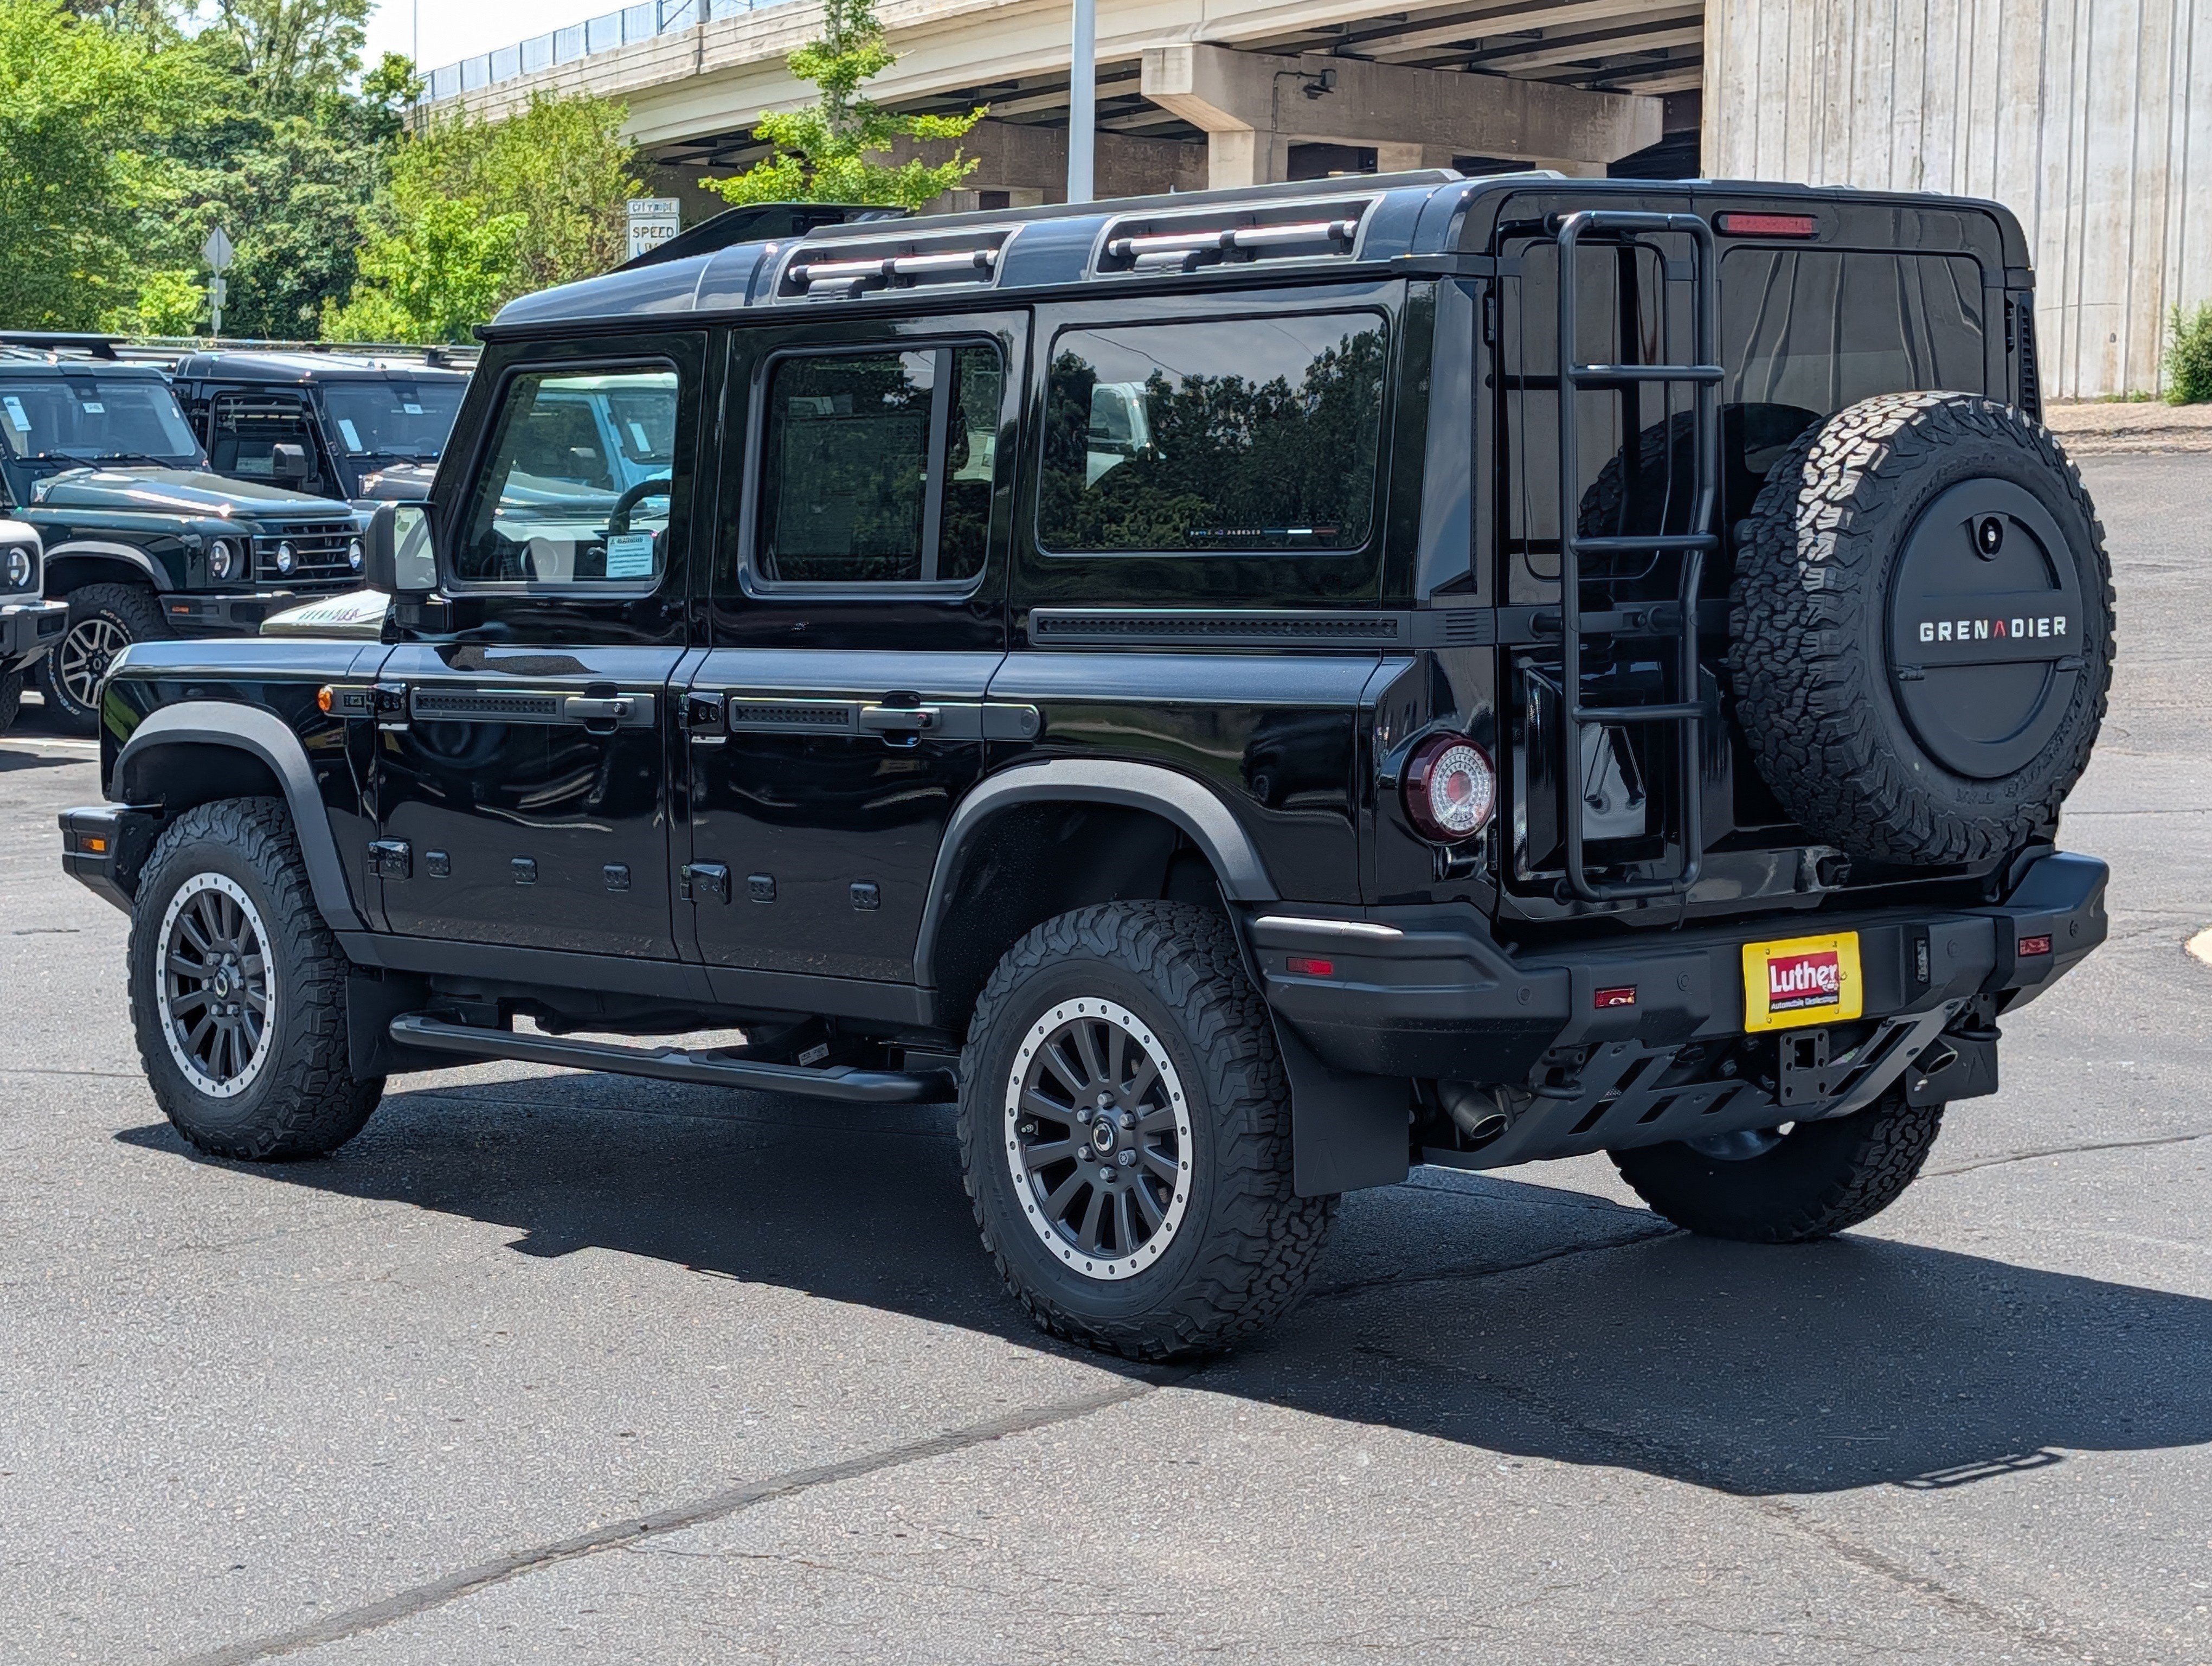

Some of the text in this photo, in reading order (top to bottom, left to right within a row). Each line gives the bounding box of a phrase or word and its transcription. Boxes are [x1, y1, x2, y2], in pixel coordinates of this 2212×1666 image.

[632, 226, 674, 238] SPEED
[1920, 616, 2066, 642] GRENADIER
[1770, 960, 1837, 993] Luther
